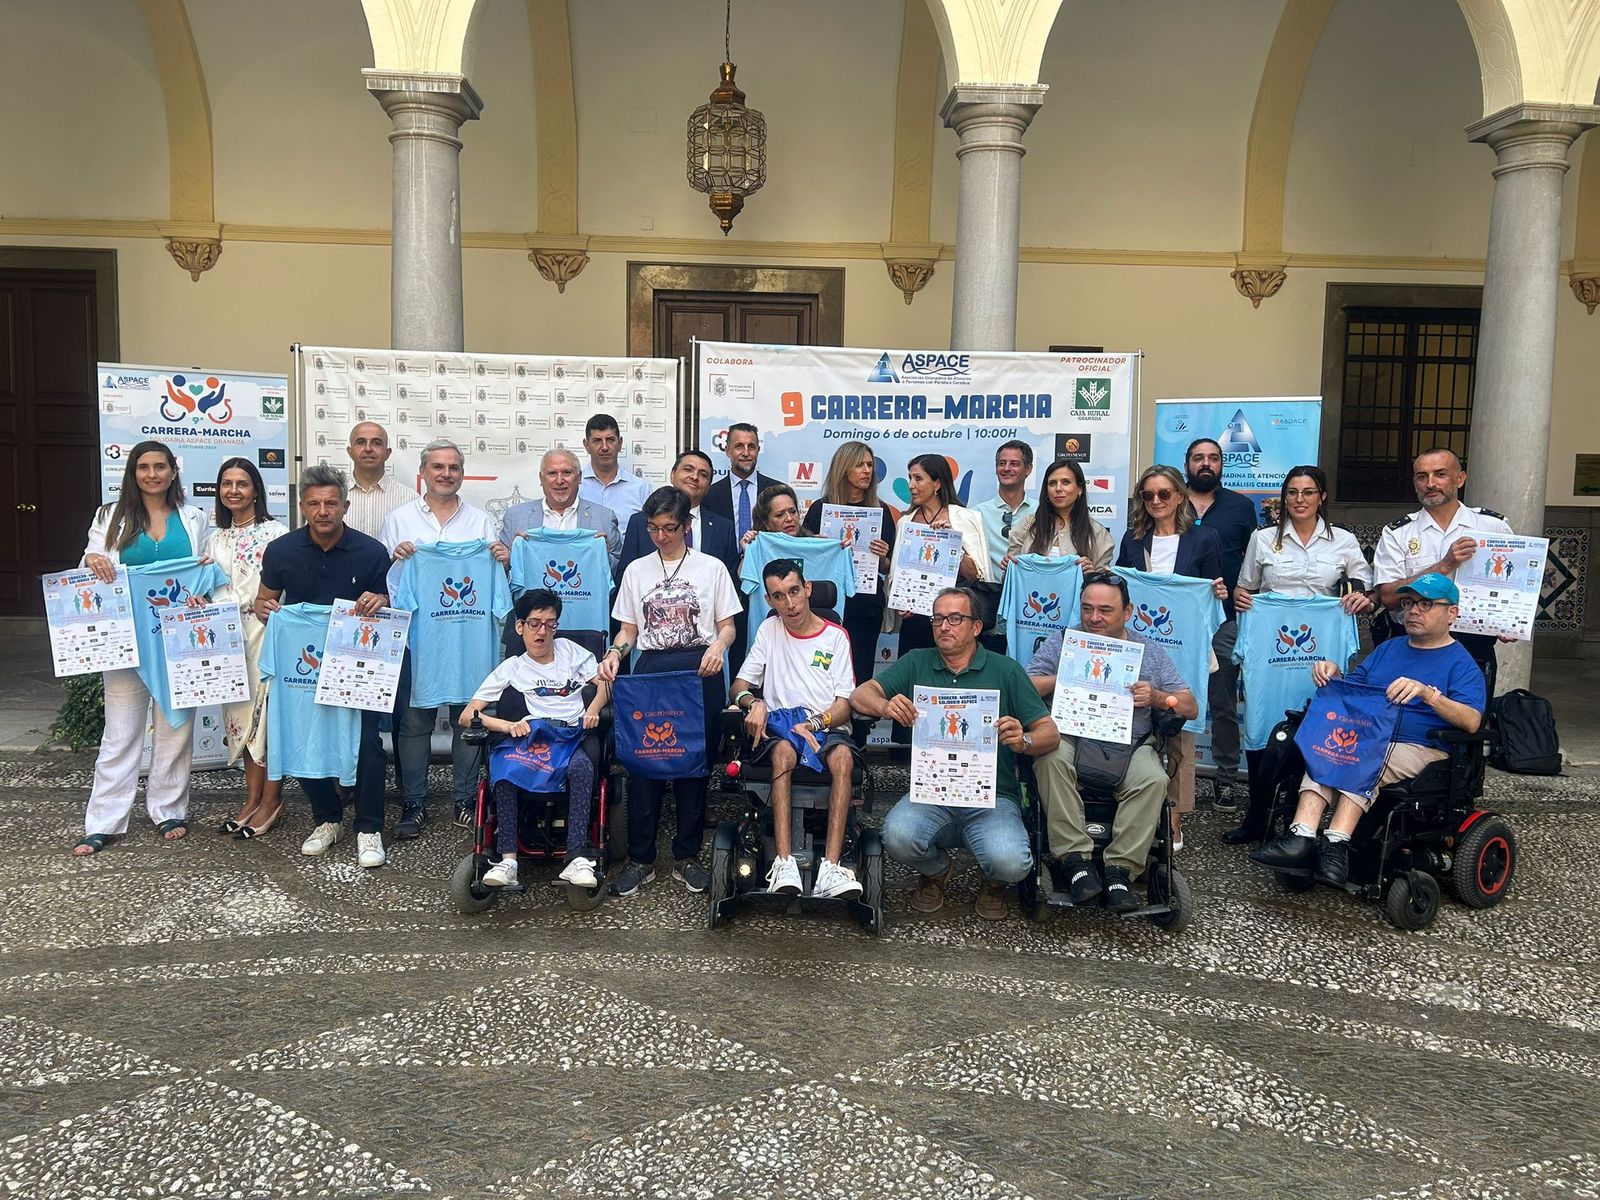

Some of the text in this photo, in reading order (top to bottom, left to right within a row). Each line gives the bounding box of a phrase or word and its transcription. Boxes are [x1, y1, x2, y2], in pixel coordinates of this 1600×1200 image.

[706, 357, 754, 366] COLABORA
[902, 353, 971, 370] ASPACE
[1060, 356, 1127, 364] PATROCINADOR
[117, 376, 149, 384] ASPACE
[781, 391, 804, 427] 9
[141, 426, 251, 438] CARRERA-MARCHA
[823, 429, 880, 441] Domingo
[883, 429, 890, 438] 6
[893, 428, 909, 438] de
[912, 428, 962, 439] octubre
[974, 428, 1017, 439] 10:00H
[1222, 453, 1260, 463] SPACE
[1223, 480, 1255, 488] PARÁLISIS
[1080, 640, 1086, 649] 9
[811, 650, 834, 670] N
[283, 676, 317, 685] CARRERA
